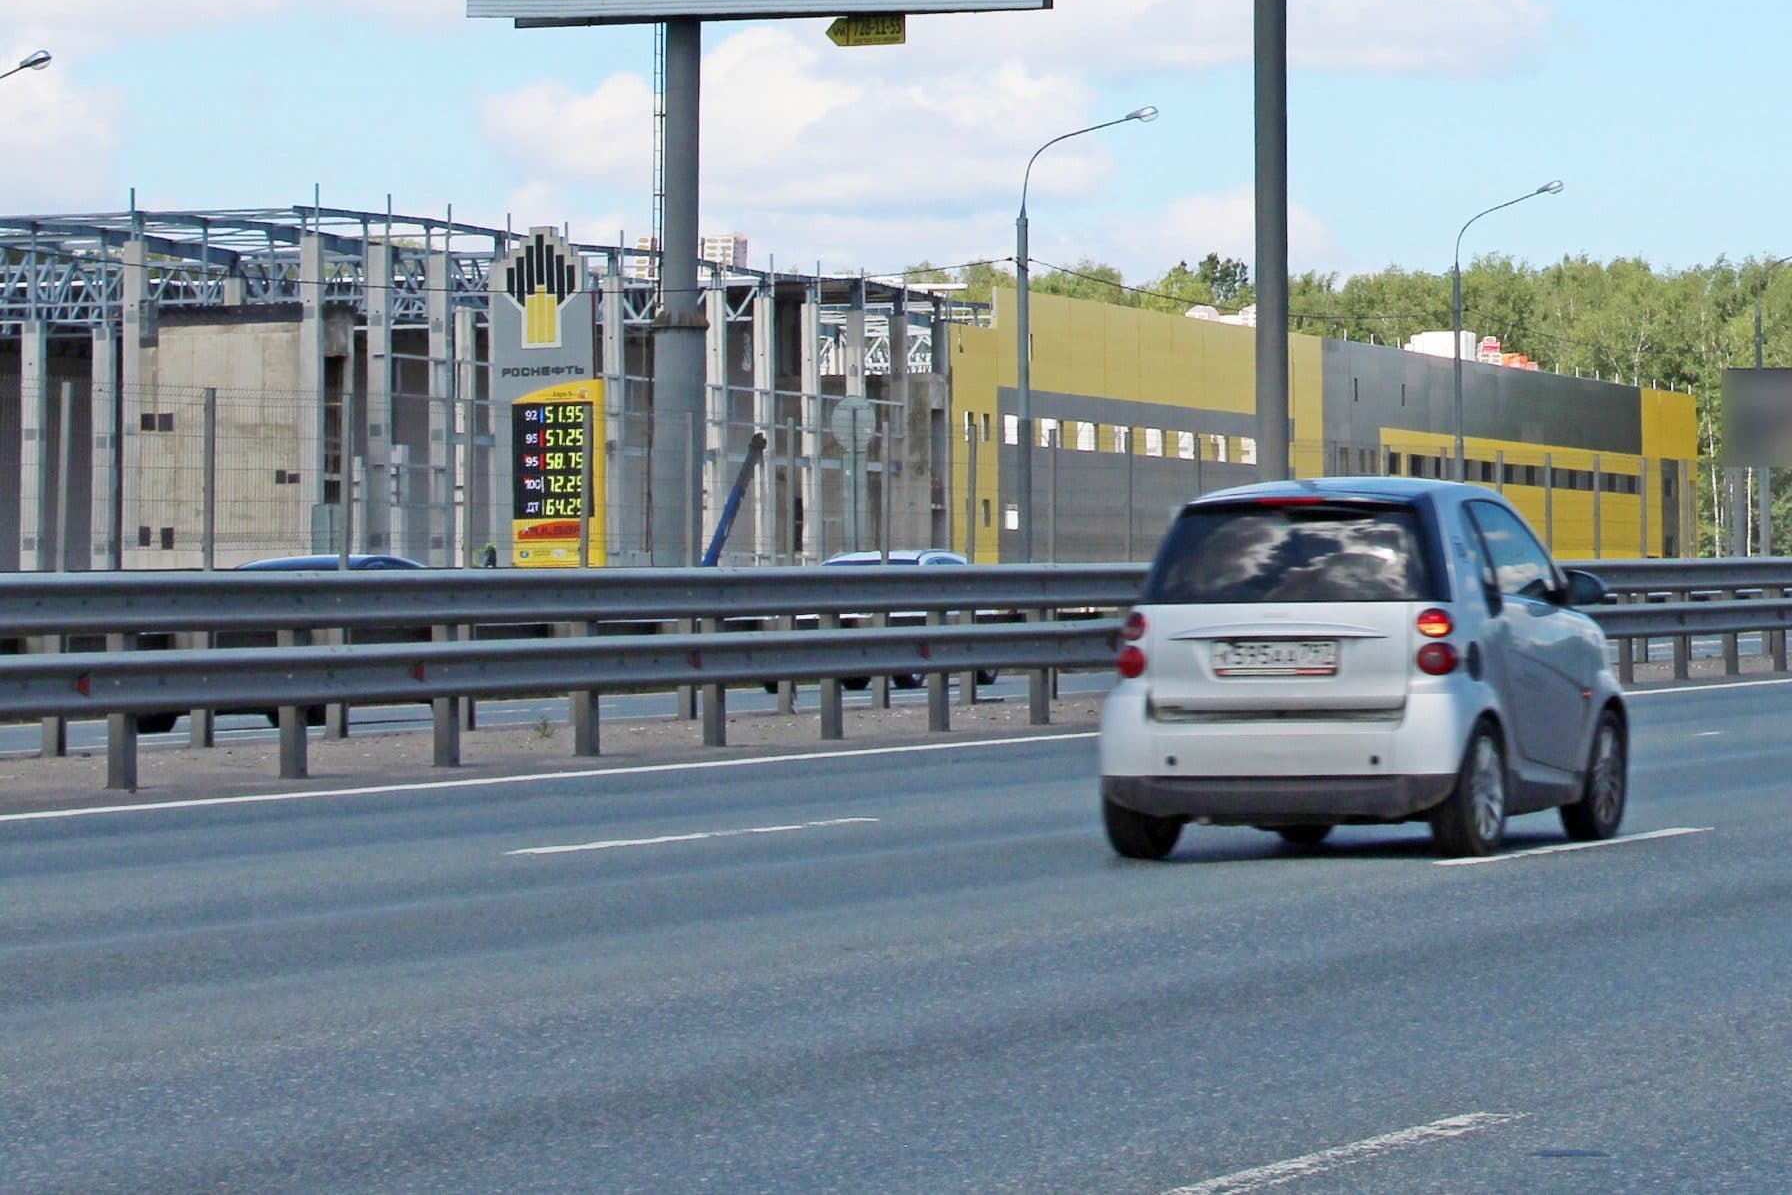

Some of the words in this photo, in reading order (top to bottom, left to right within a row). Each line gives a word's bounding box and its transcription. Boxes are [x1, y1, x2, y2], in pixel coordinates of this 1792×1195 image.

[502, 366, 584, 377] РОСНЕФТЬ
[525, 410, 538, 421] 92
[545, 406, 584, 423] 51.95
[525, 433, 538, 444] 95
[545, 429, 584, 447] 57.25
[525, 456, 538, 467] 95
[546, 452, 583, 470] 58.75
